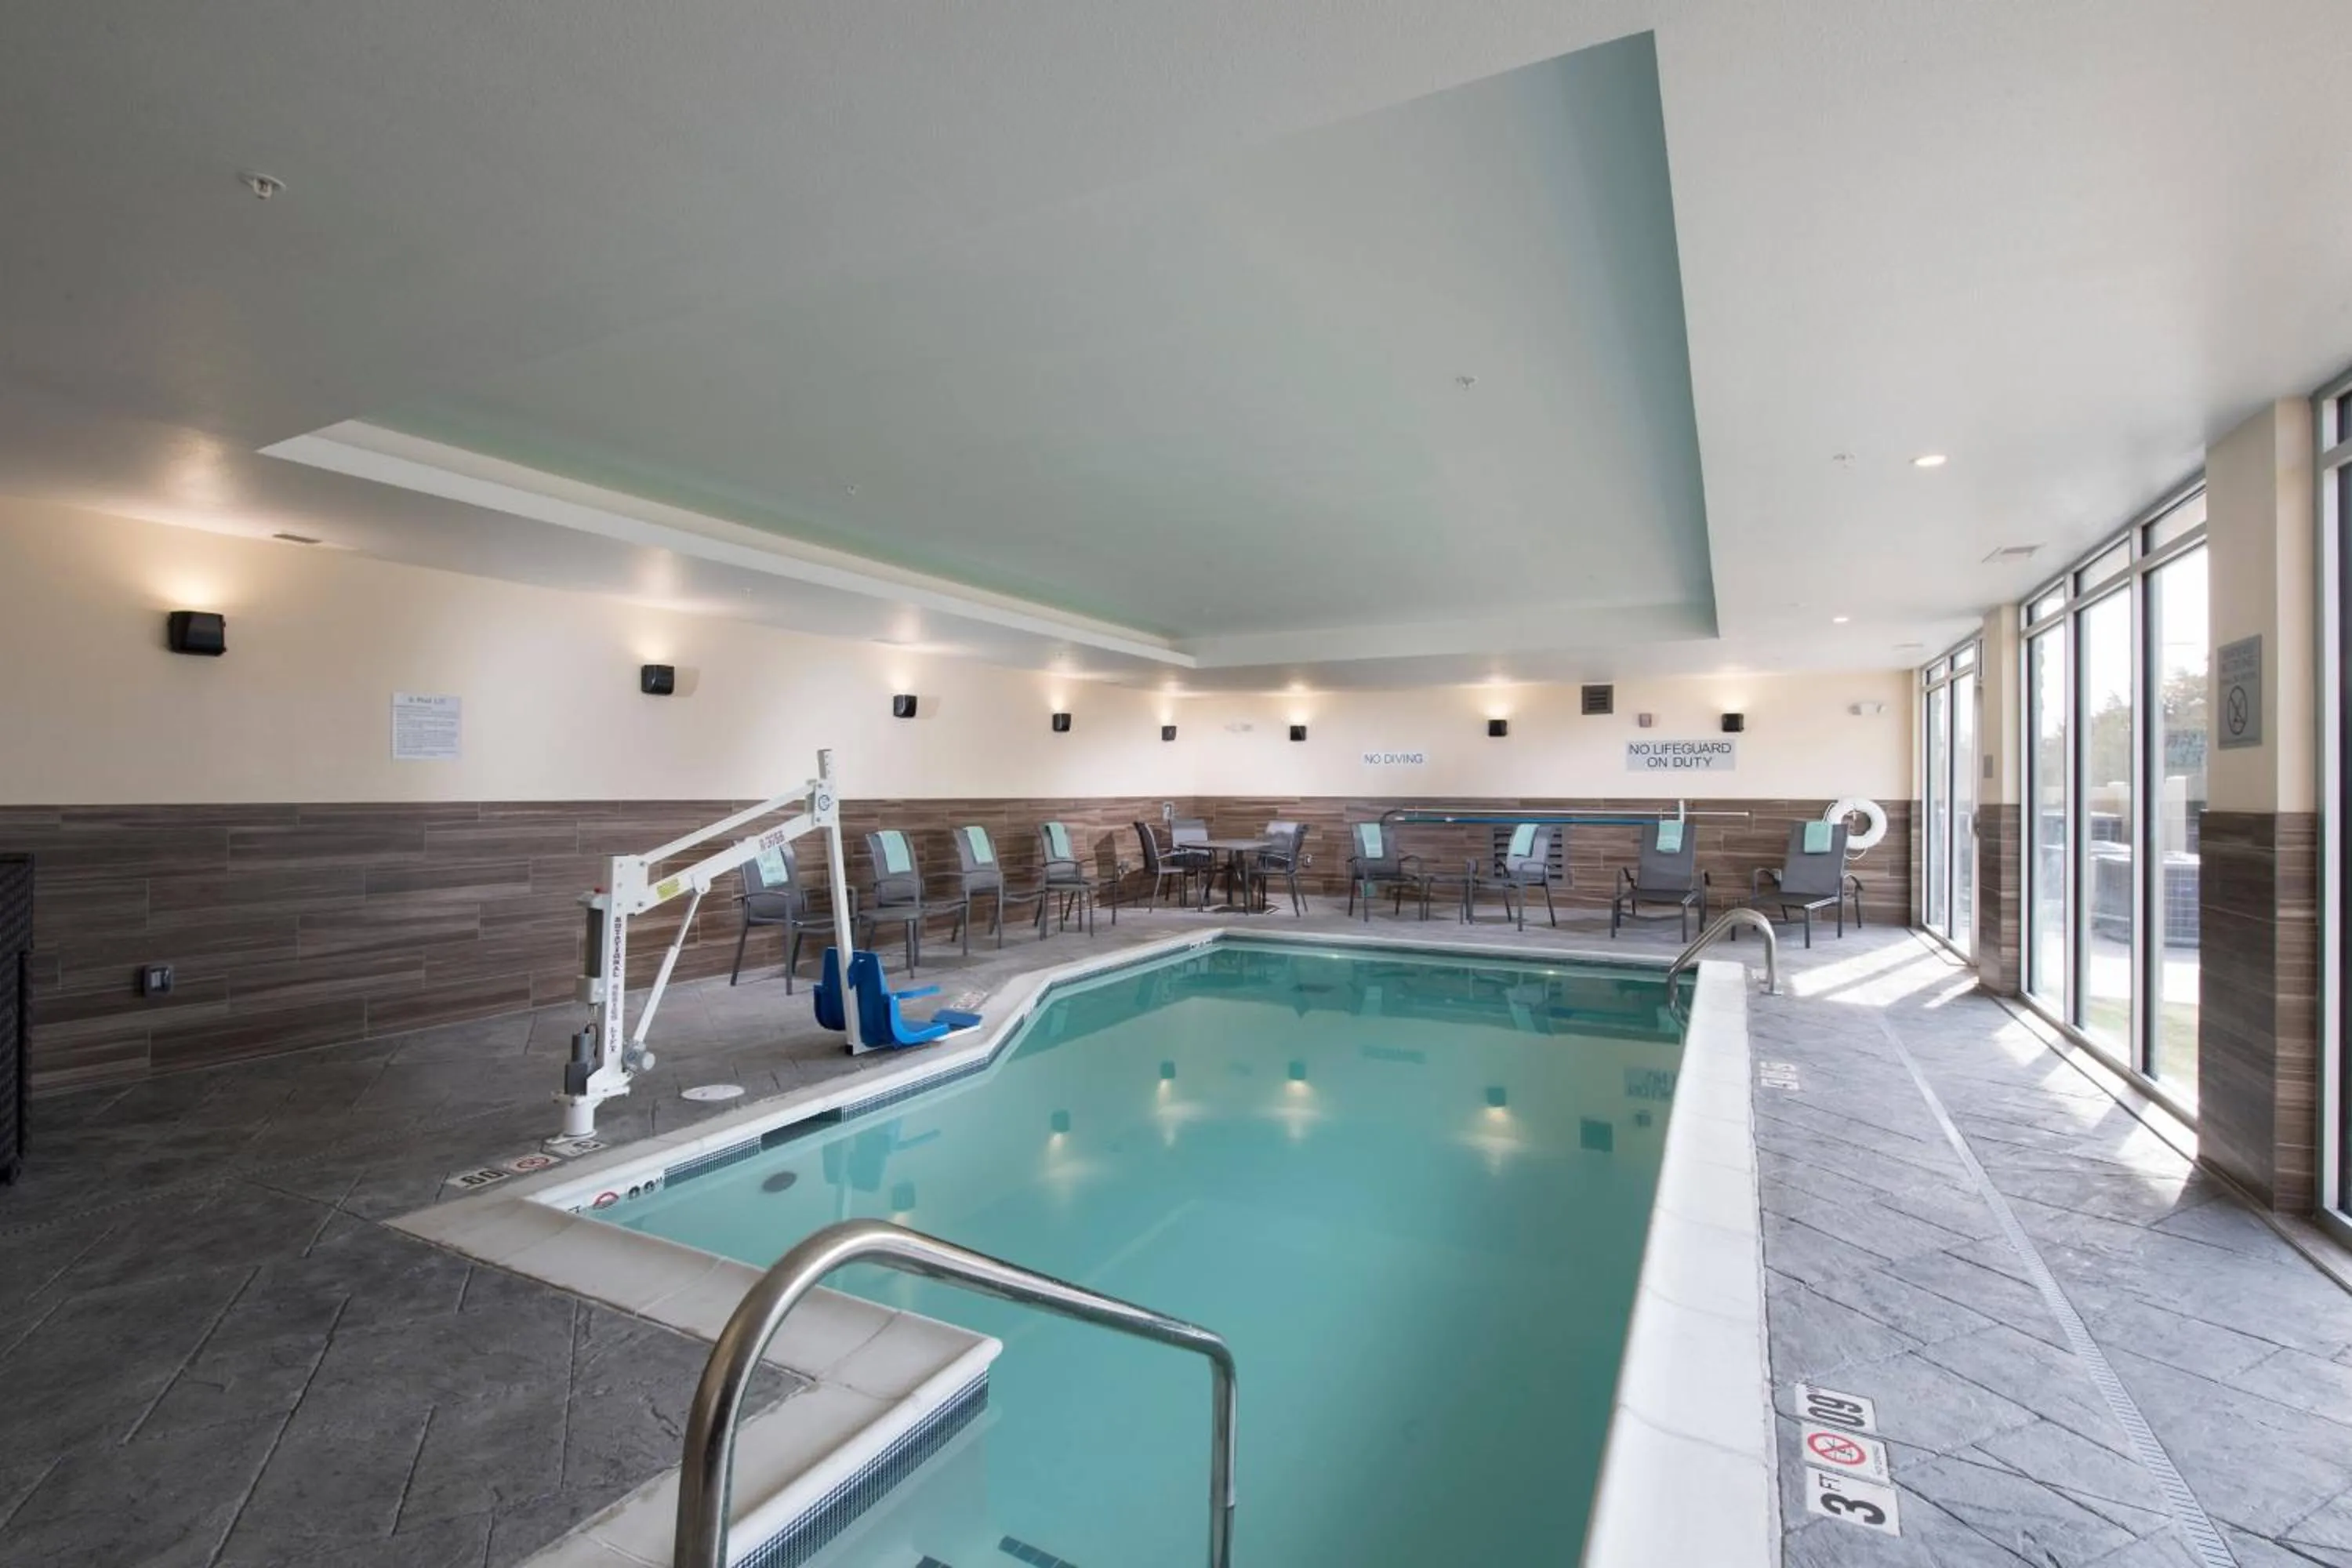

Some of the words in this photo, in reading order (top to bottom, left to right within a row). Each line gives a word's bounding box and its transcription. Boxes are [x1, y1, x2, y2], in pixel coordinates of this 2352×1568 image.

[1628, 744, 1650, 755] NO
[1653, 742, 1732, 755] LIFEGUARD
[1363, 753, 1381, 764] NO
[1384, 753, 1423, 764] DIVING
[1647, 757, 1668, 768] ON
[1673, 757, 1713, 768] DUTY
[1819, 1473, 1842, 1492] FT
[1820, 1492, 1886, 1525] 3
